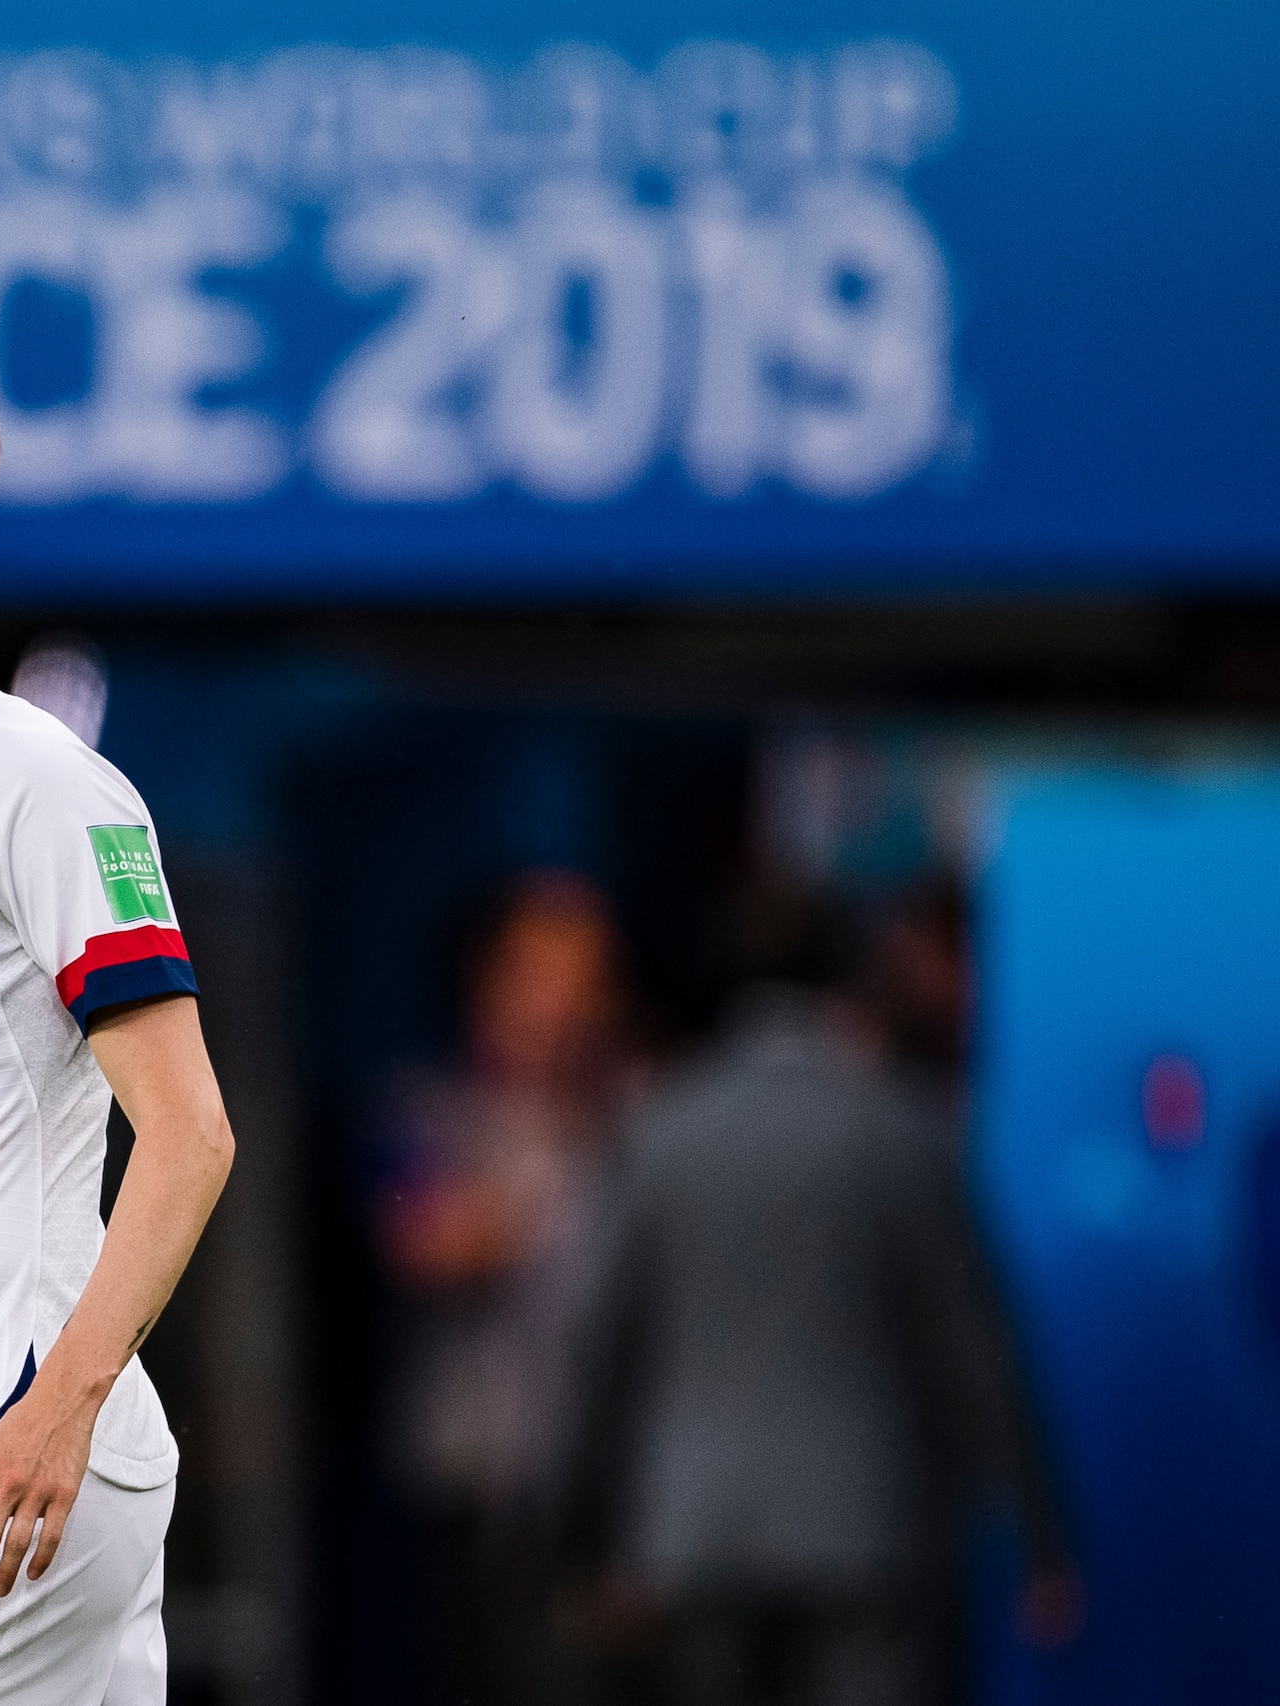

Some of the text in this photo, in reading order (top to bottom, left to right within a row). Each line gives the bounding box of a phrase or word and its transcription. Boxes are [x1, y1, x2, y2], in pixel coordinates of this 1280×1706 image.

[318, 178, 954, 504] 2019
[99, 850, 153, 864] LIVING
[139, 882, 161, 895] FIFA
